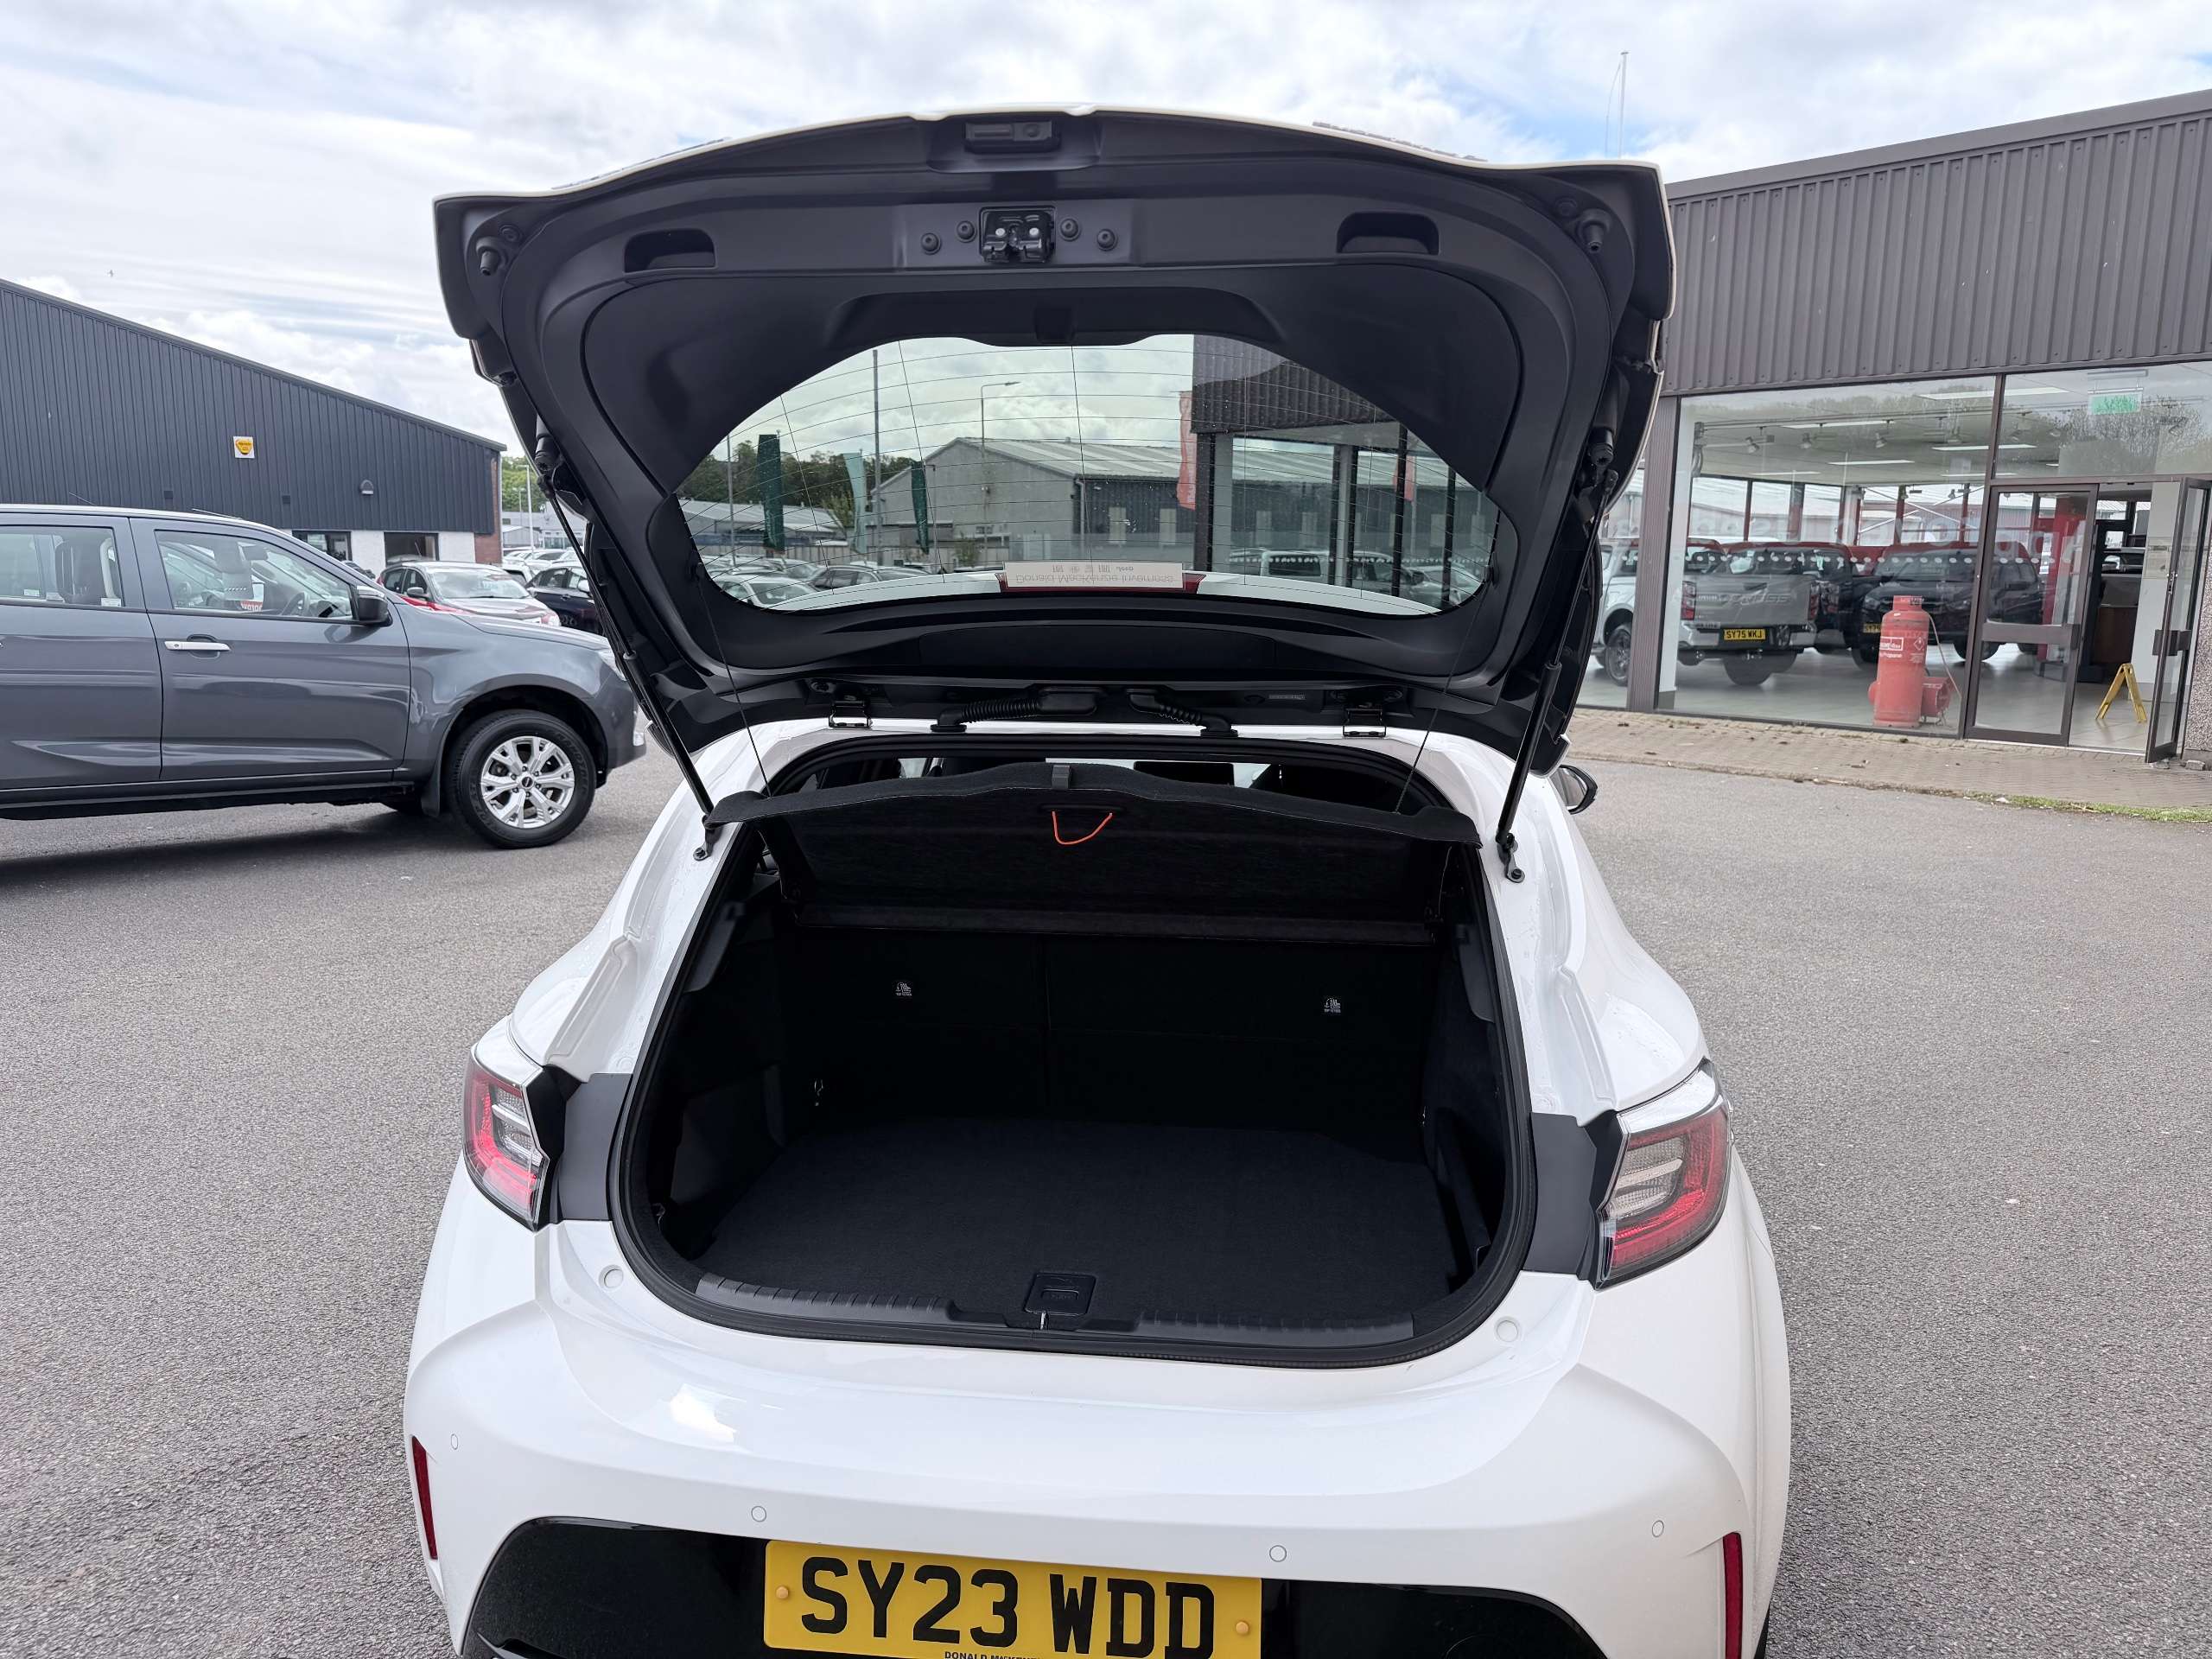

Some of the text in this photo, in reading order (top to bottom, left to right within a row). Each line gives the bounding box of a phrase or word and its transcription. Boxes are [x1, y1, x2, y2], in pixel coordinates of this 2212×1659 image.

[1726, 629, 1763, 639] SY75 WKJ
[801, 1556, 1215, 1659] SY23 WDD
